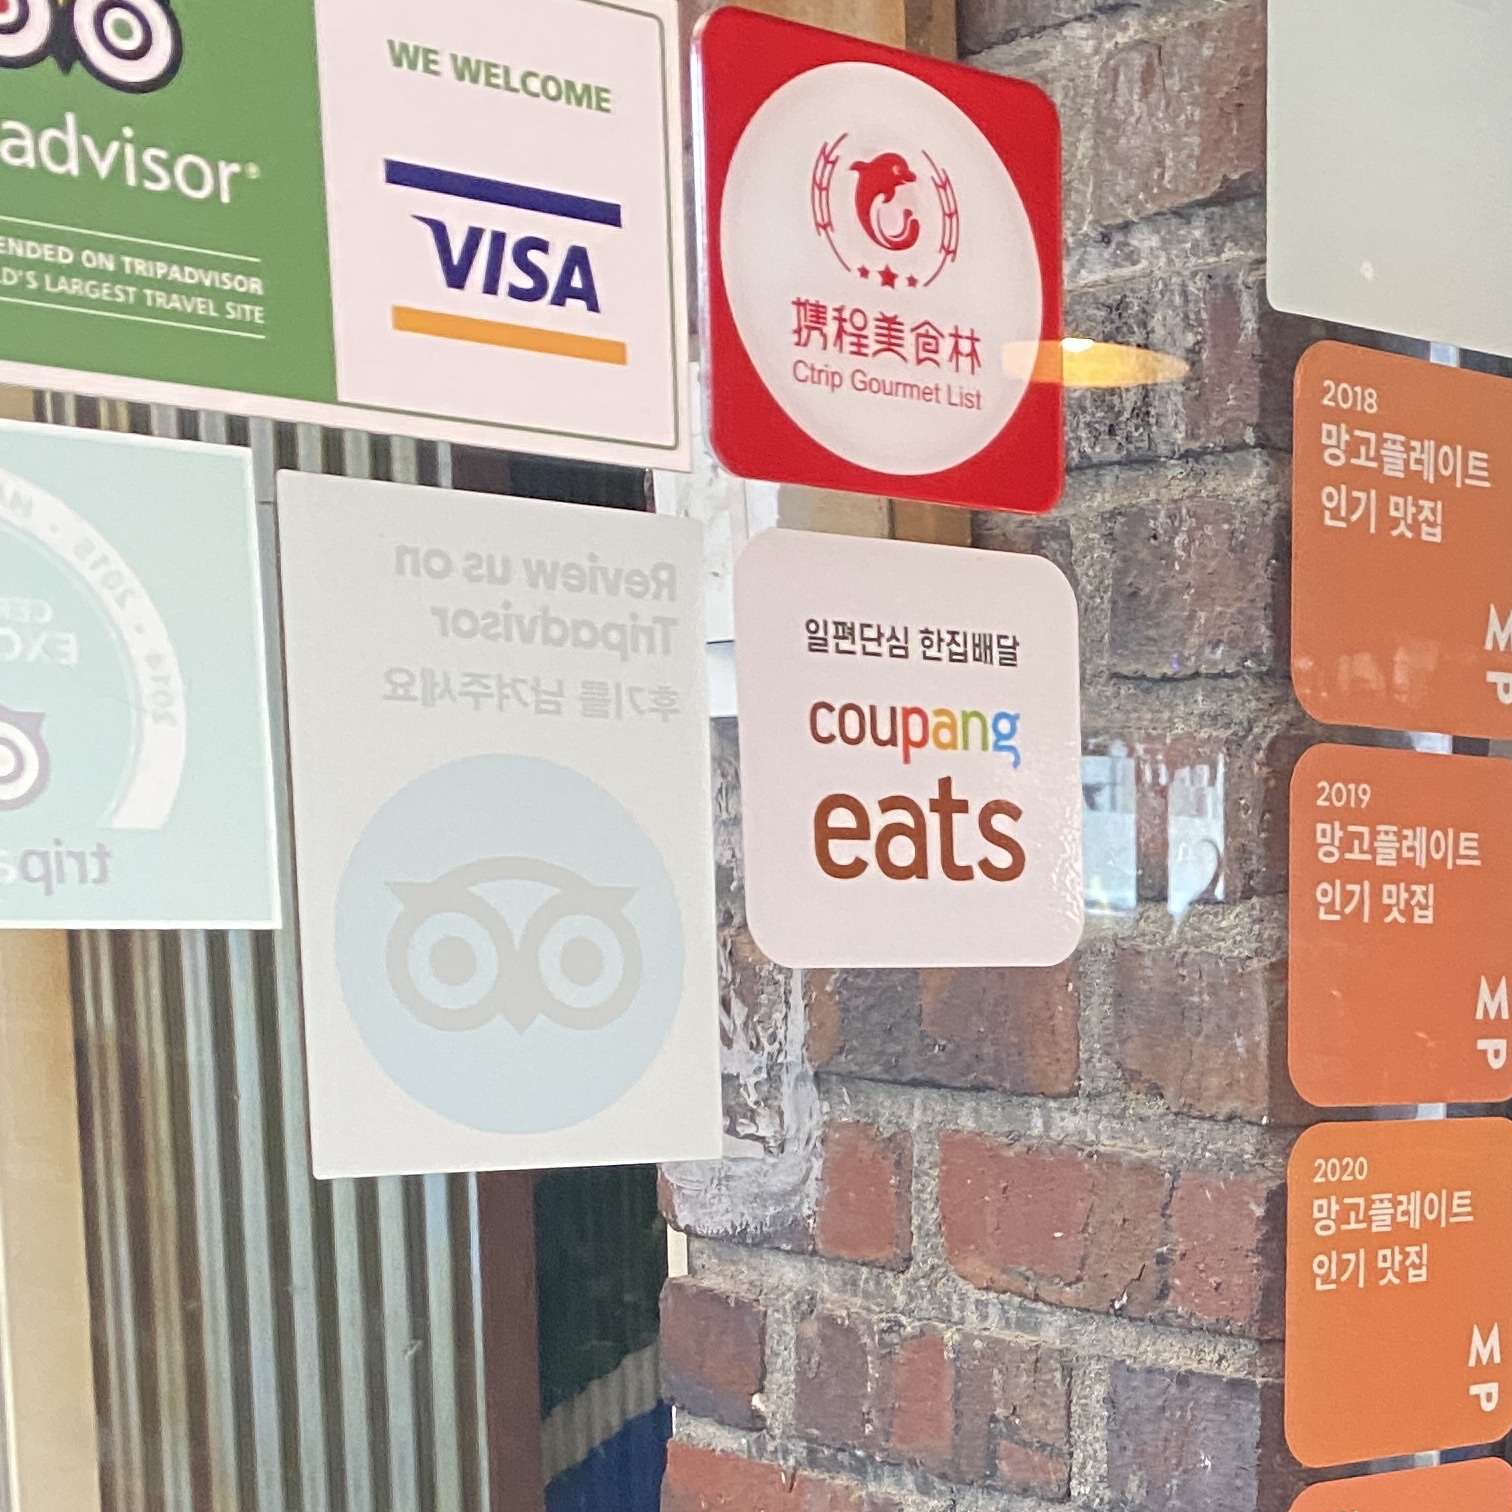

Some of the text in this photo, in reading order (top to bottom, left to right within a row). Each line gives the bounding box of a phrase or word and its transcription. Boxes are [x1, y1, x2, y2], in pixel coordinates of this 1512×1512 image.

[387, 38, 612, 114] WE WELCOME
[81, 249, 115, 271] ON
[120, 254, 264, 296] TRIPADVISOR
[411, 213, 601, 314] VISA
[44, 274, 137, 303] LARGEST
[143, 288, 219, 317] TRAVEL
[225, 300, 265, 324] SITE
[791, 296, 982, 376] 携程美食林
[792, 359, 982, 410] Ctrip Gourmet List
[1322, 380, 1378, 414] 2018
[1321, 423, 1492, 488] 망고플레이트
[1321, 485, 1443, 543] 인기 맛집
[804, 617, 1019, 667] 일편단심 한집배달
[809, 699, 1021, 769] coupang
[1316, 781, 1372, 808] 2019
[813, 775, 1026, 883] eats
[1315, 821, 1482, 870] 망고플레이트
[1316, 880, 1435, 925] 인기 맛집
[1313, 1156, 1368, 1183] 2020
[1312, 1189, 1474, 1237] 망고플레이트
[1312, 1243, 1428, 1291] 인기 맛집
